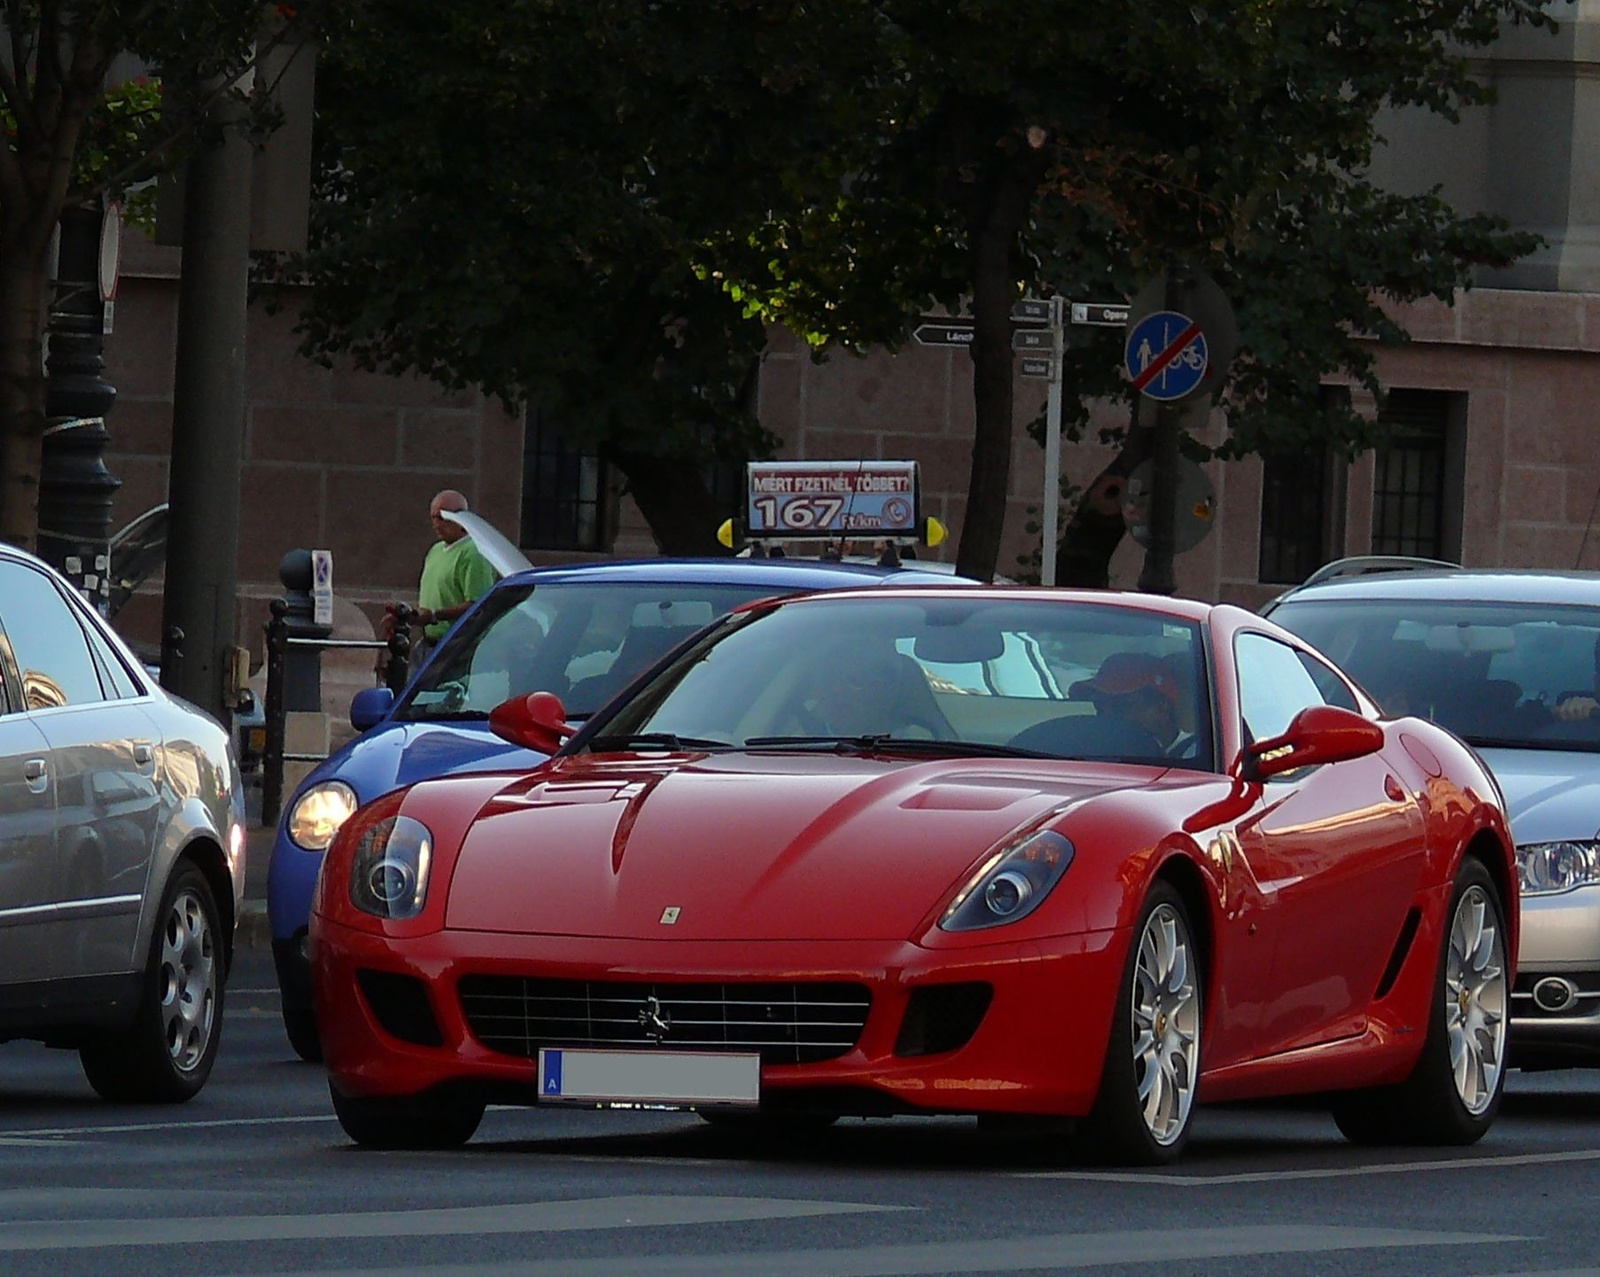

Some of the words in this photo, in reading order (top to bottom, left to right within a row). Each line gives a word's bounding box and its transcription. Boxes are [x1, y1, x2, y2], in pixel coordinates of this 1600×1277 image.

[754, 473, 793, 492] MIÉRT
[795, 473, 852, 492] FIZETNÉL
[854, 473, 909, 492] TÖBBET?
[755, 497, 843, 528] 167
[841, 513, 882, 528] Ft/km
[548, 1078, 557, 1089] A
